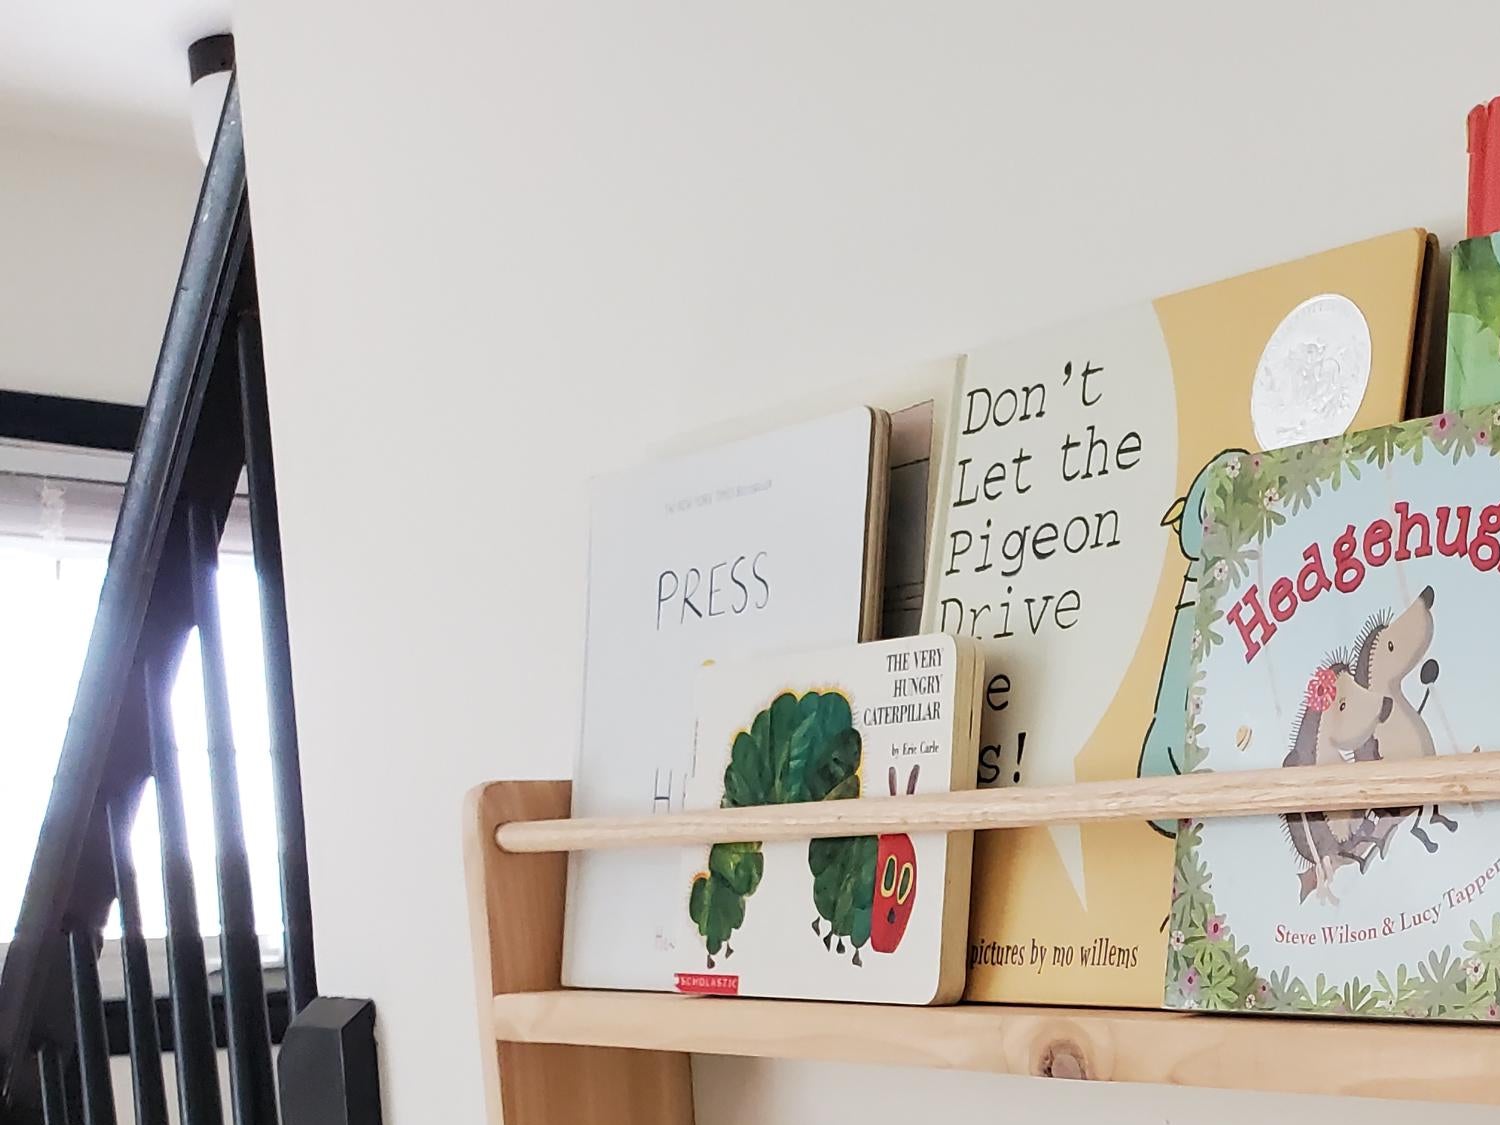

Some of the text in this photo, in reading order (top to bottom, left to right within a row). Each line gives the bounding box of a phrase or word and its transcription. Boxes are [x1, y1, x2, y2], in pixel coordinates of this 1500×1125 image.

[961, 360, 1105, 435] Don't
[951, 424, 1144, 508] Let the
[944, 507, 1122, 577] Pigeon
[656, 551, 770, 631] PRESS
[939, 585, 1082, 639] Drive
[886, 647, 945, 673] THE VERY
[893, 673, 944, 698] HUNGRY
[863, 700, 941, 727] CATERPILLAR
[891, 739, 940, 759] by Eric Carle
[1274, 923, 1317, 946] Steve
[1320, 923, 1377, 946] Wilson
[1381, 917, 1396, 936] &
[1399, 902, 1443, 932] Lucy
[970, 937, 1139, 975] pictures by mo willems
[679, 975, 738, 990] SCHOLASTIC
